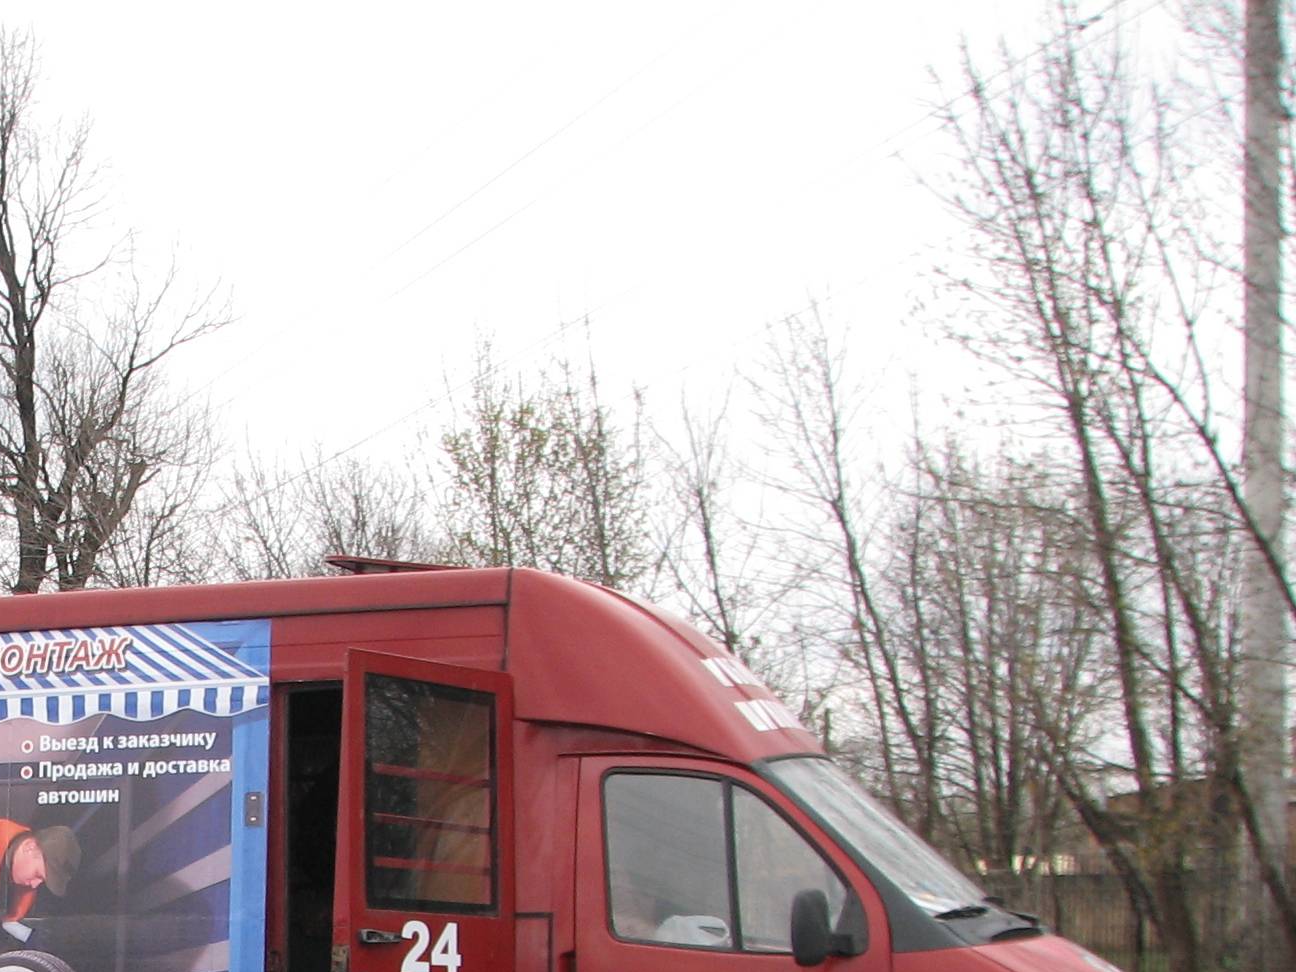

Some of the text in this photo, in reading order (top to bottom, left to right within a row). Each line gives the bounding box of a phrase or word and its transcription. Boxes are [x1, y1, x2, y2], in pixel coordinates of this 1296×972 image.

[39, 731, 216, 753] Выезд к заказчику
[38, 758, 231, 782] Продажа и доставка
[37, 789, 119, 804] автошин
